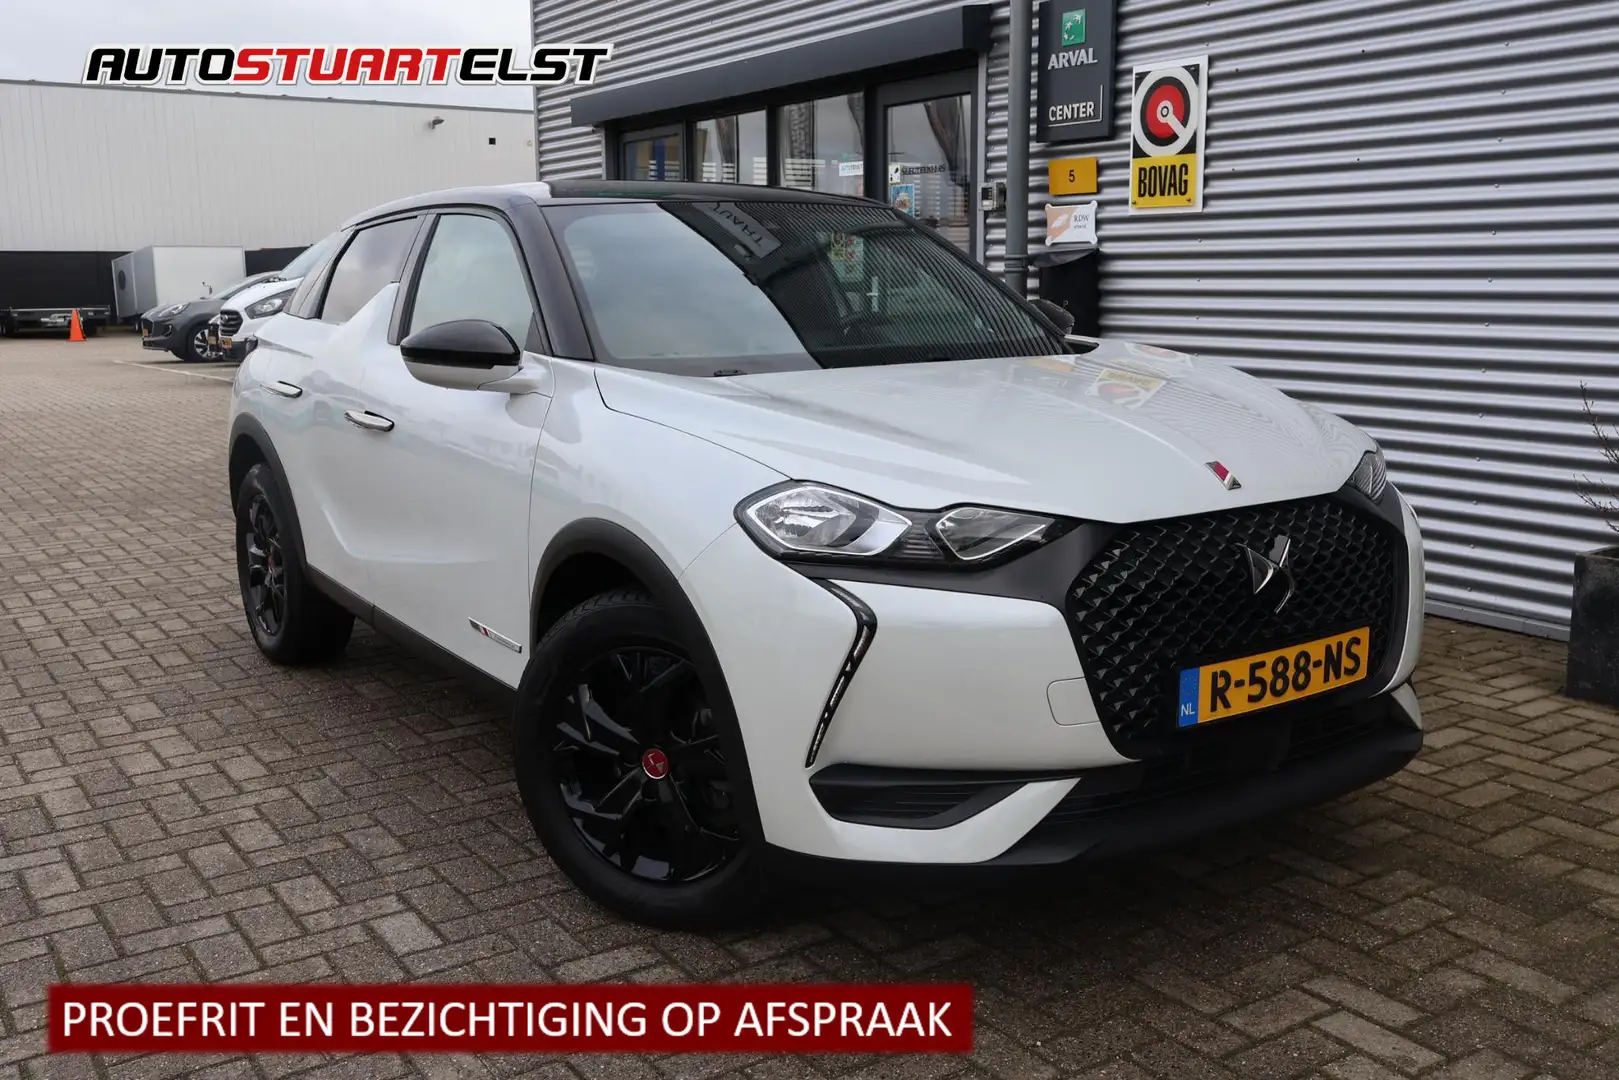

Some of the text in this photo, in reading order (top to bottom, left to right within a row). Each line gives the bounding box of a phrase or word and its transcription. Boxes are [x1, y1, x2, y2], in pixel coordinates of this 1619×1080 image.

[1047, 48, 1098, 71] ARVAL
[1048, 101, 1095, 122] CENTER
[1068, 169, 1076, 183] 5
[1137, 163, 1189, 198] BOVAG
[1209, 636, 1361, 713] R-588-NS
[1180, 703, 1196, 717] NL
